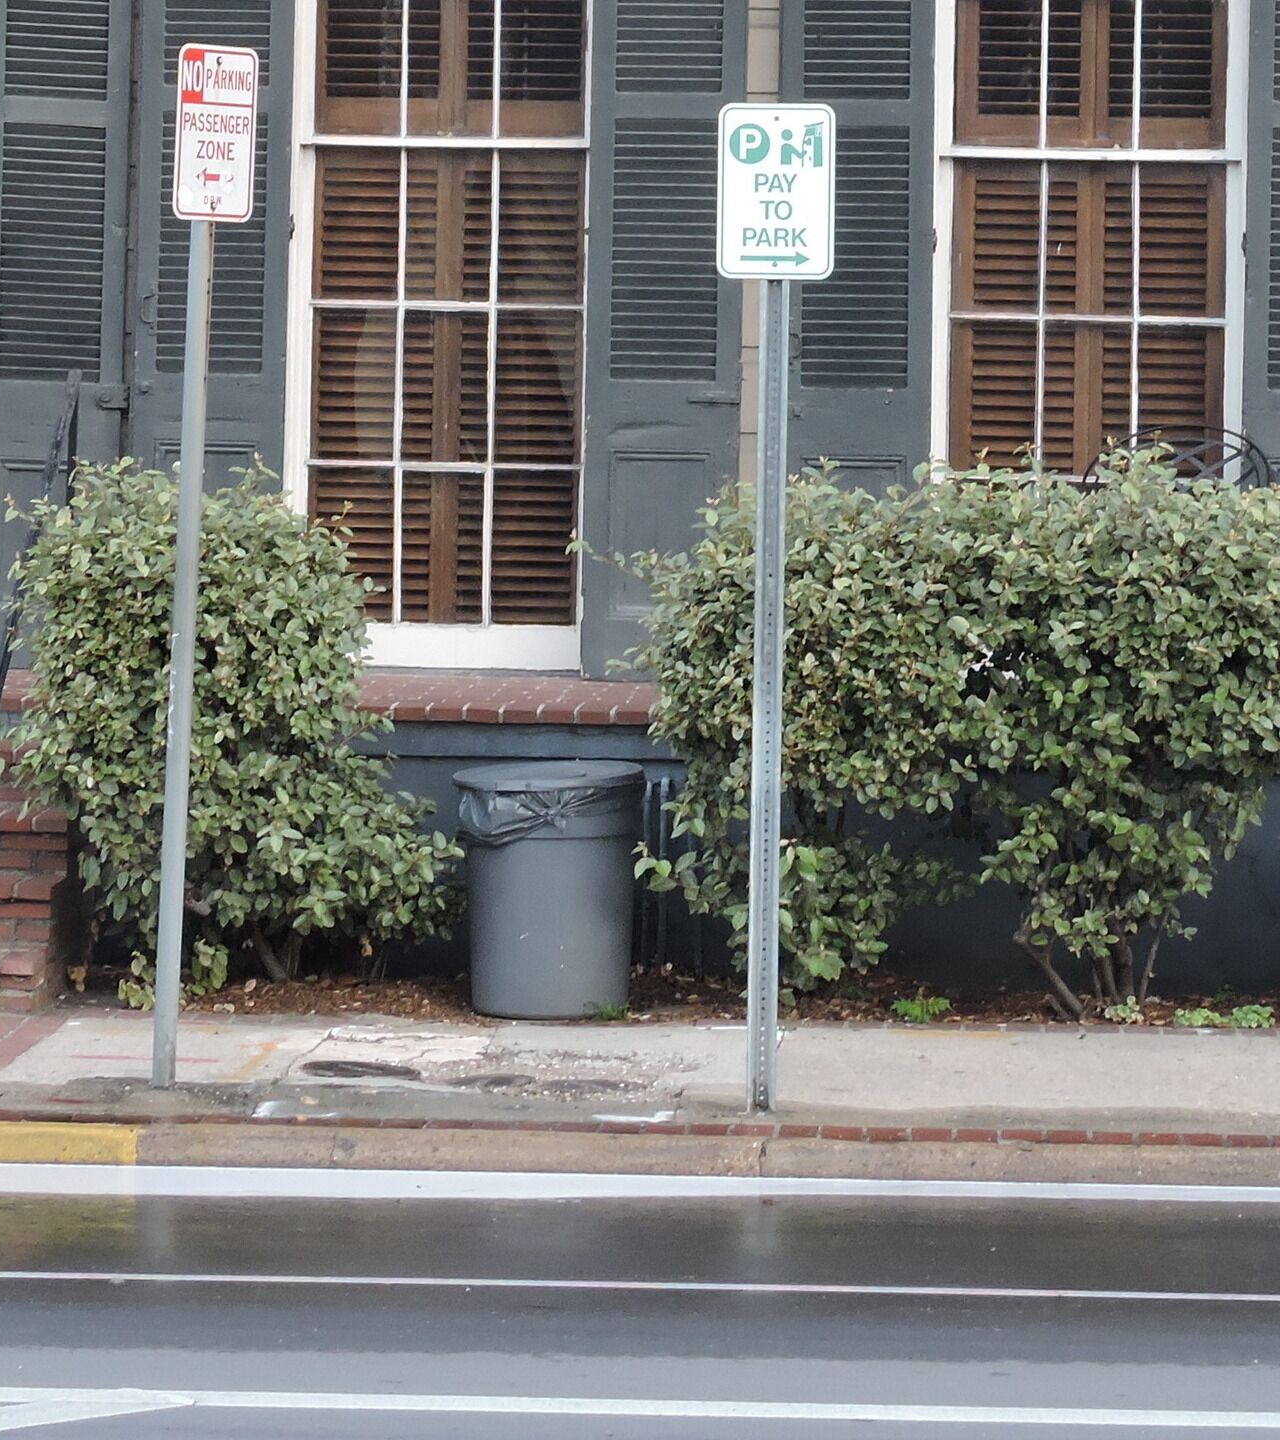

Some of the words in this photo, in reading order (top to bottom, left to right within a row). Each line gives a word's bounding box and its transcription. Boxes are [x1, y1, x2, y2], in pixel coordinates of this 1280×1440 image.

[182, 60, 203, 92] NO
[205, 68, 252, 92] PARKING
[183, 113, 250, 135] PASSENGER
[196, 140, 235, 161] ZONE
[753, 173, 798, 193] PAY
[759, 200, 793, 221] TO
[742, 227, 808, 248] PARK
